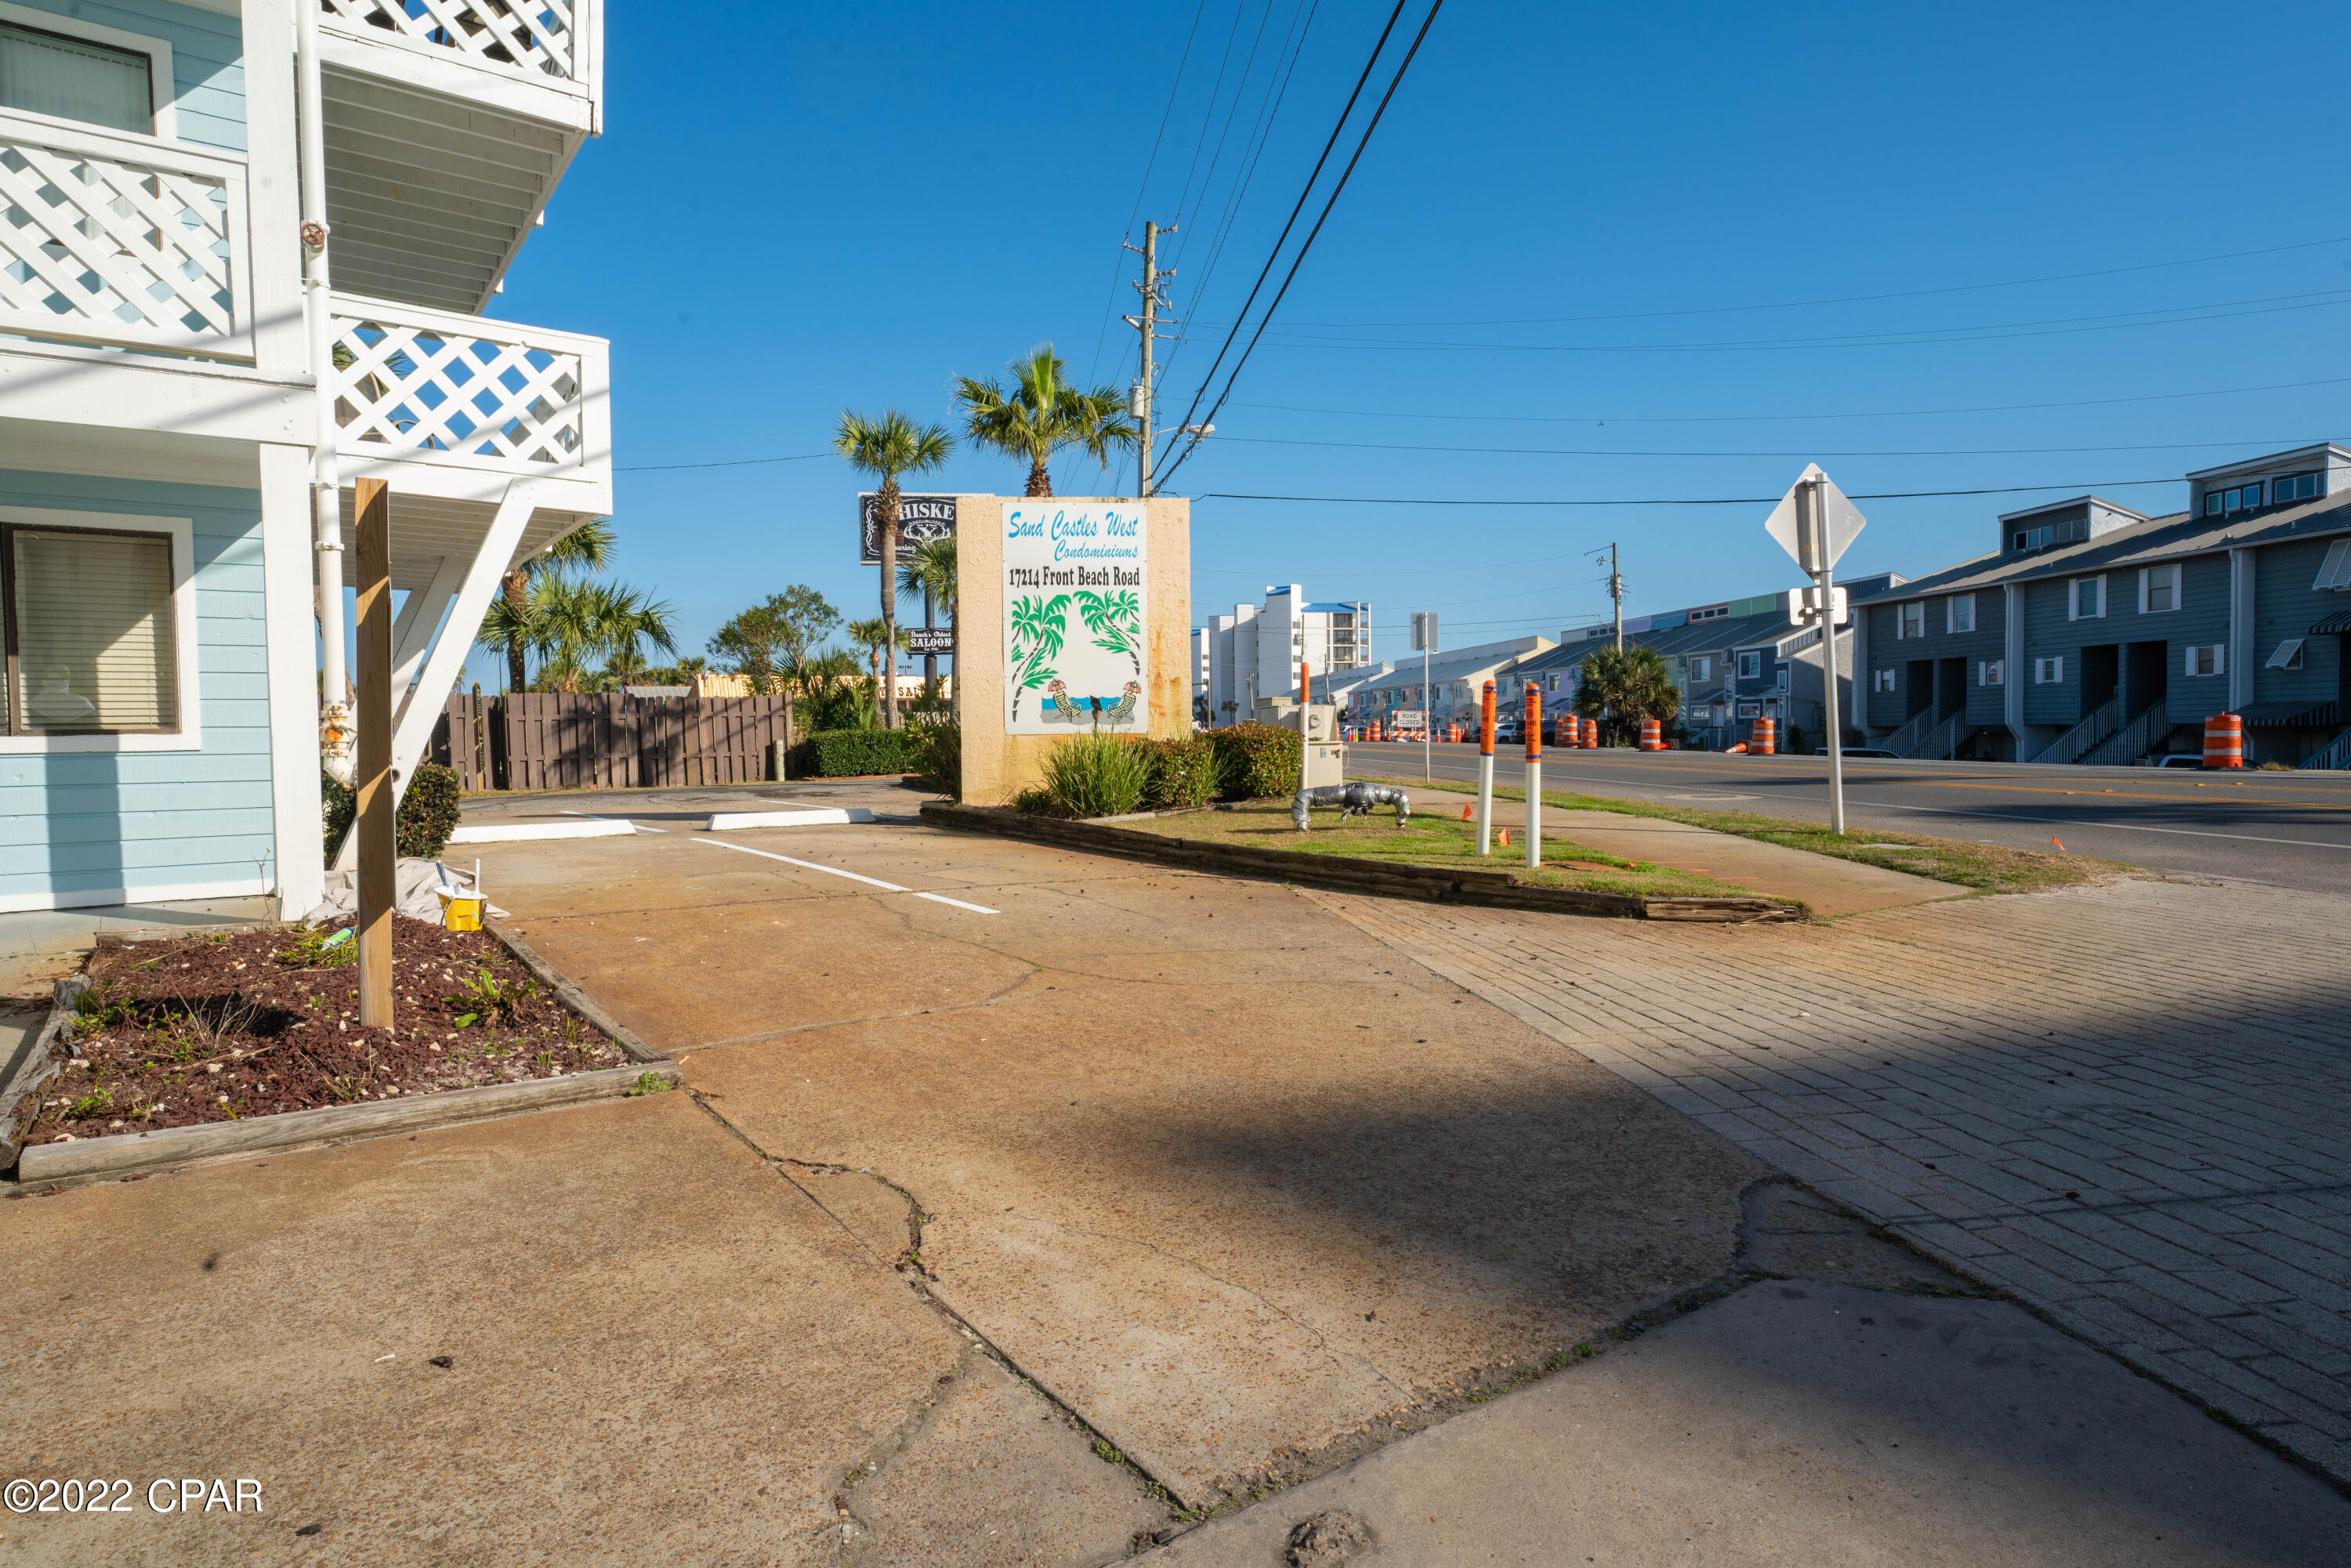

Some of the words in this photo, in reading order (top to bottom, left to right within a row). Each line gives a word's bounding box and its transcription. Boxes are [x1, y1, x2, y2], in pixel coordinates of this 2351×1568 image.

[898, 503, 955, 520] HISKE
[916, 527, 939, 538] Y
[1009, 511, 1045, 538] Sand
[1051, 510, 1098, 541] Castles
[1106, 511, 1139, 537] West
[894, 544, 916, 554] ouring
[1054, 539, 1139, 562] Condominiums
[1009, 568, 1040, 588] 17214
[1043, 566, 1074, 586] Front
[1078, 566, 1110, 586] Beach
[1114, 566, 1140, 586] Road
[910, 638, 951, 647] SALOON
